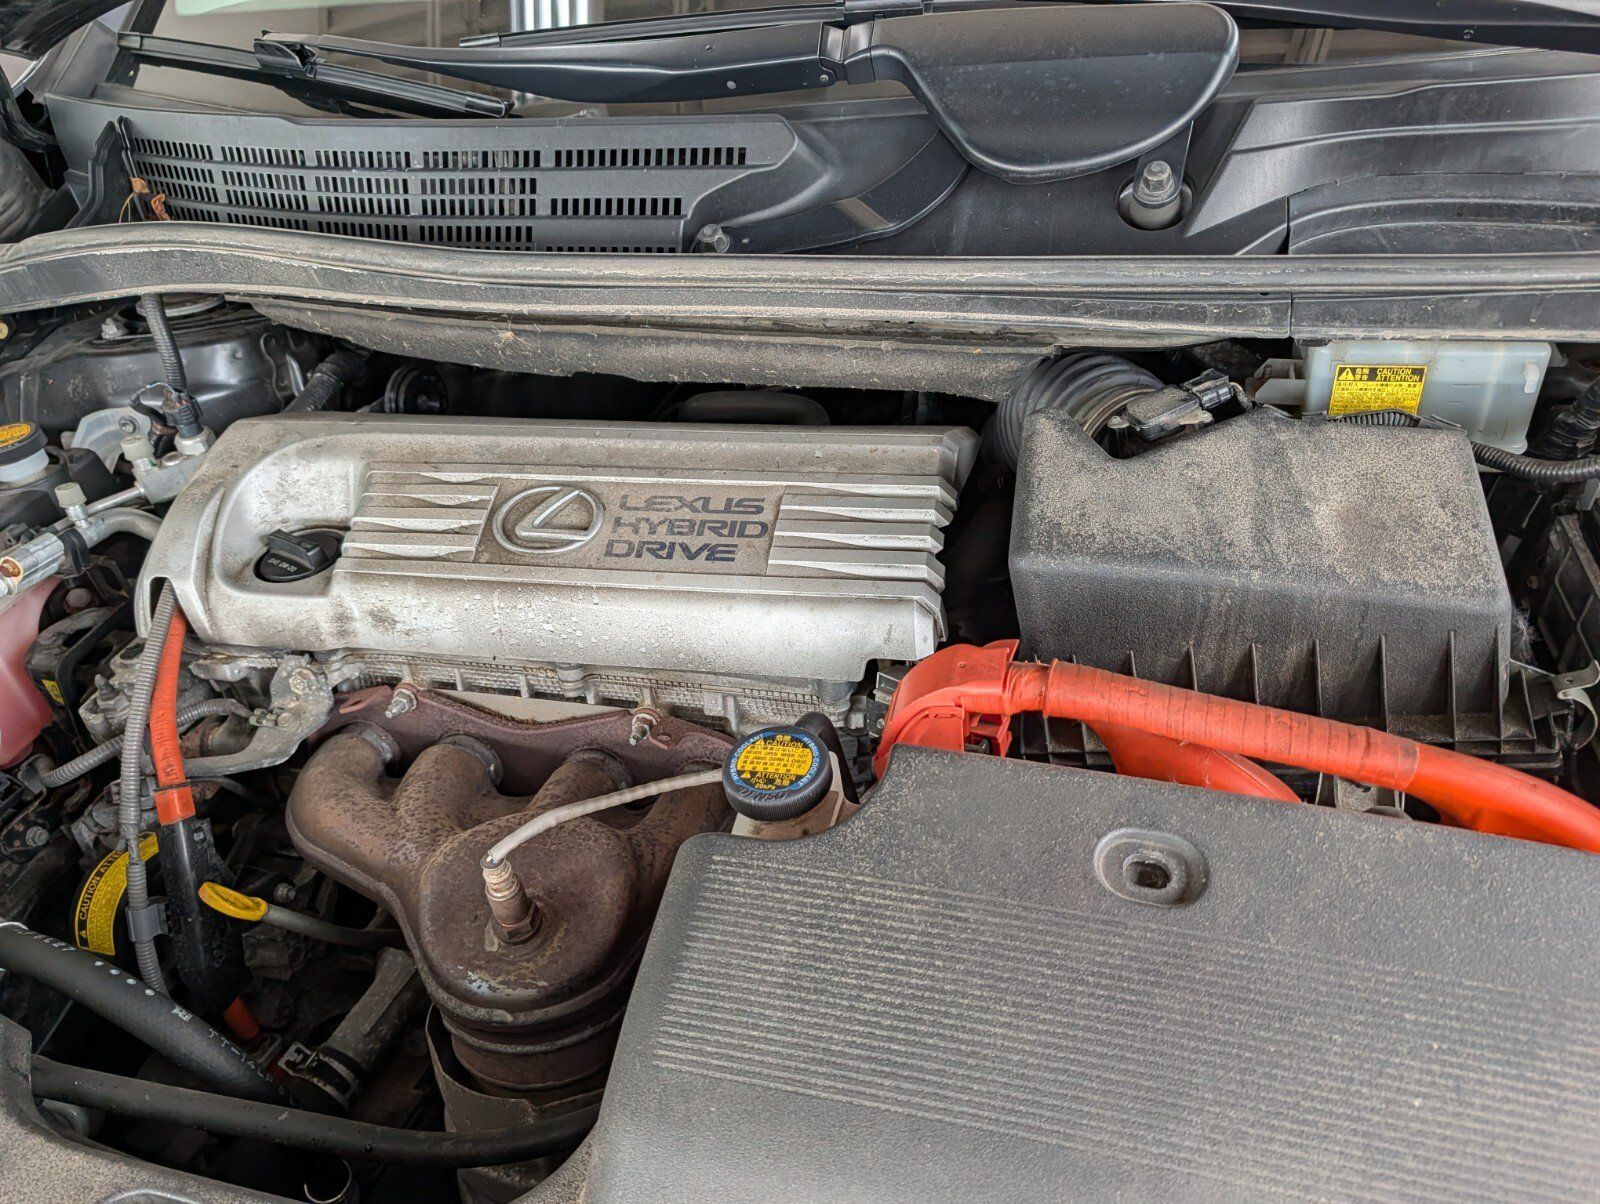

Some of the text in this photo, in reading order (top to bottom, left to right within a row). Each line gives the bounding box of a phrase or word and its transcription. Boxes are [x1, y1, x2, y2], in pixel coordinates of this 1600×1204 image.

[1375, 374, 1420, 382] ATTENTION
[619, 494, 766, 516] LEXUS
[611, 516, 769, 539] HYBRID
[603, 539, 739, 563] DRIVE
[766, 740, 803, 748] CAUTION
[755, 771, 797, 781] ATTENTION
[80, 876, 101, 920] CAUTION
